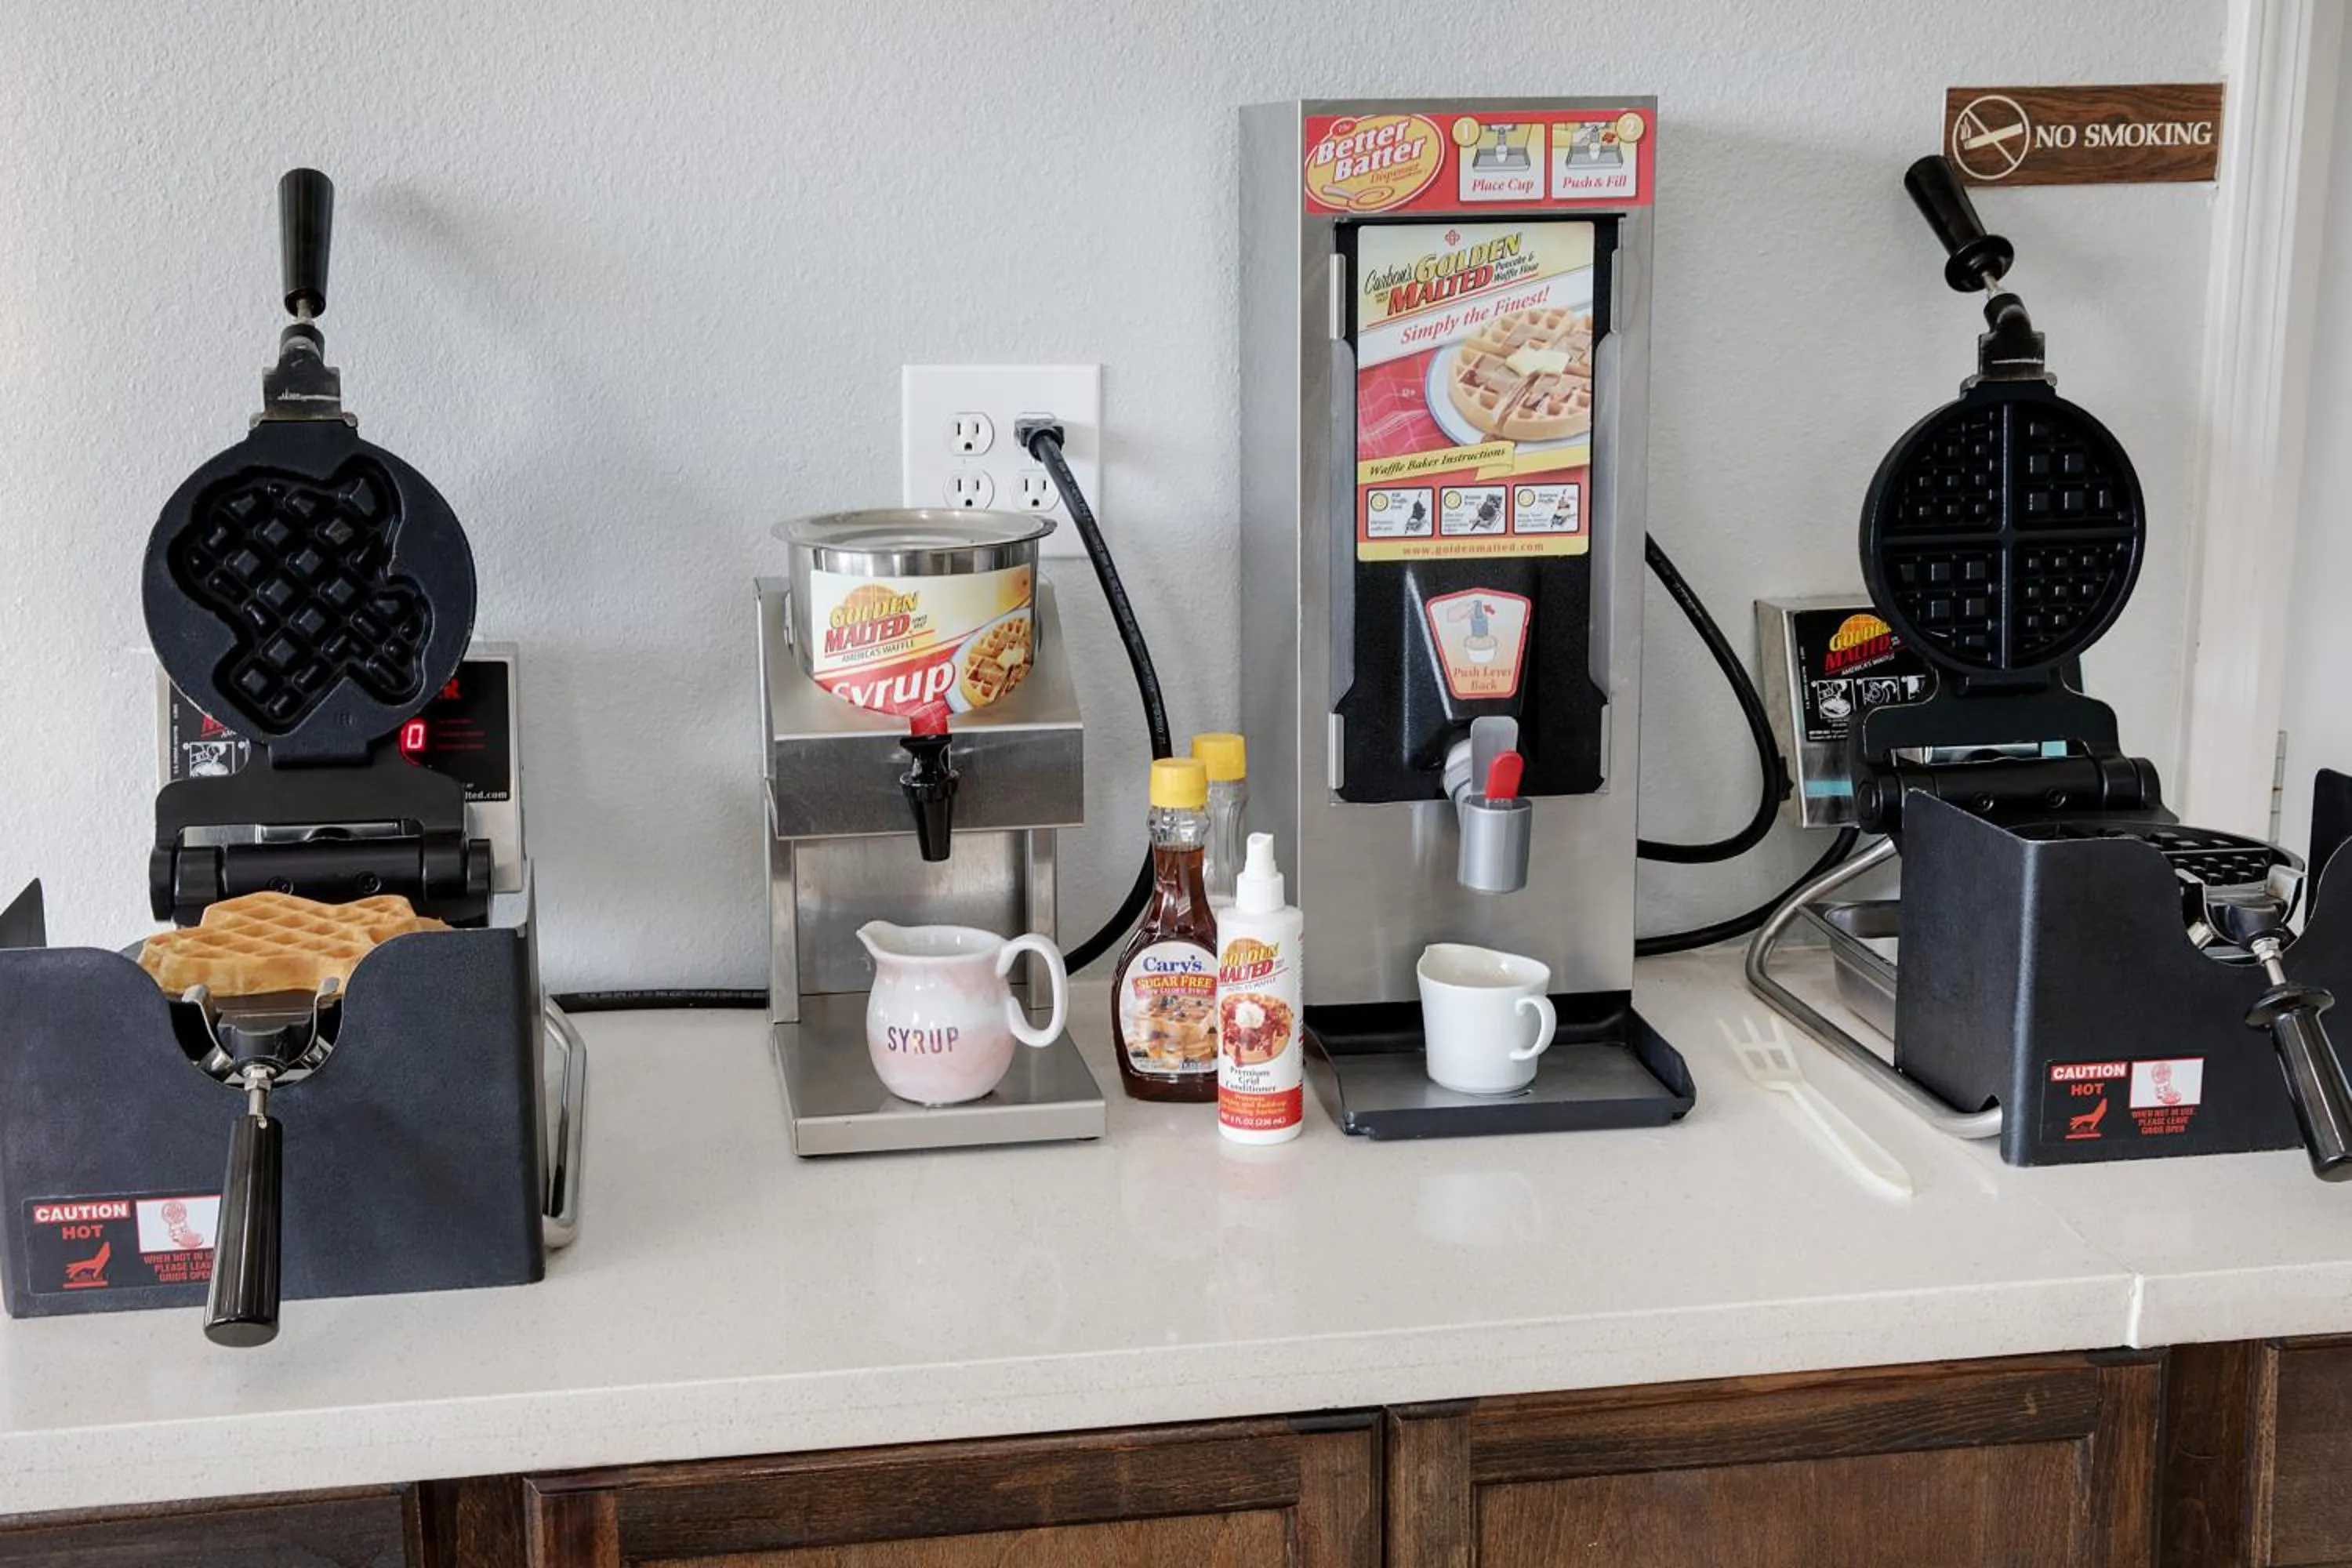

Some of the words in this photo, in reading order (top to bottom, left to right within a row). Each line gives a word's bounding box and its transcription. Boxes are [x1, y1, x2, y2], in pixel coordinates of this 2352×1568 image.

[1462, 121, 1471, 141] 1
[1626, 119, 1636, 136] 2
[2035, 124, 2077, 149] NO
[2085, 122, 2213, 148] SMOKING
[1314, 121, 1410, 167] Better
[1332, 136, 1427, 184] Batter
[1472, 178, 1504, 193] Place
[1508, 176, 1534, 193] Cup
[1563, 175, 1593, 189] Push
[1606, 174, 1628, 188] Fill
[1414, 231, 1523, 284] GOLDEN
[1387, 263, 1494, 315] MALTED
[1401, 314, 1459, 344] Simply
[1462, 306, 1490, 325] the
[1494, 285, 1551, 315] Finest!
[1370, 459, 1404, 477] Waffle
[1407, 457, 1439, 472] Baker
[1441, 447, 1506, 465] Instructions
[1402, 543, 1544, 556] www.goldenmalted.com
[829, 590, 920, 629] GOLDEN
[824, 614, 910, 653] MALTED
[1825, 633, 1891, 671] MALTED
[1454, 667, 1479, 678] Push
[1481, 666, 1512, 677] Lever
[1471, 680, 1497, 691] Back
[1143, 954, 1202, 975] Cary's
[1219, 959, 1273, 983] MALTED
[1138, 975, 1178, 989] SUGAR
[1181, 975, 1214, 989] FREE
[887, 1025, 959, 1054] SYRUP
[1229, 1065, 1270, 1076] Premium
[1239, 1075, 1260, 1085] Grid
[2053, 1064, 2126, 1080] CAUTION
[1225, 1080, 1276, 1092] Conditioner
[2070, 1083, 2105, 1096] HOT
[36, 1203, 128, 1222] CAUTION
[62, 1225, 103, 1240] HOT
